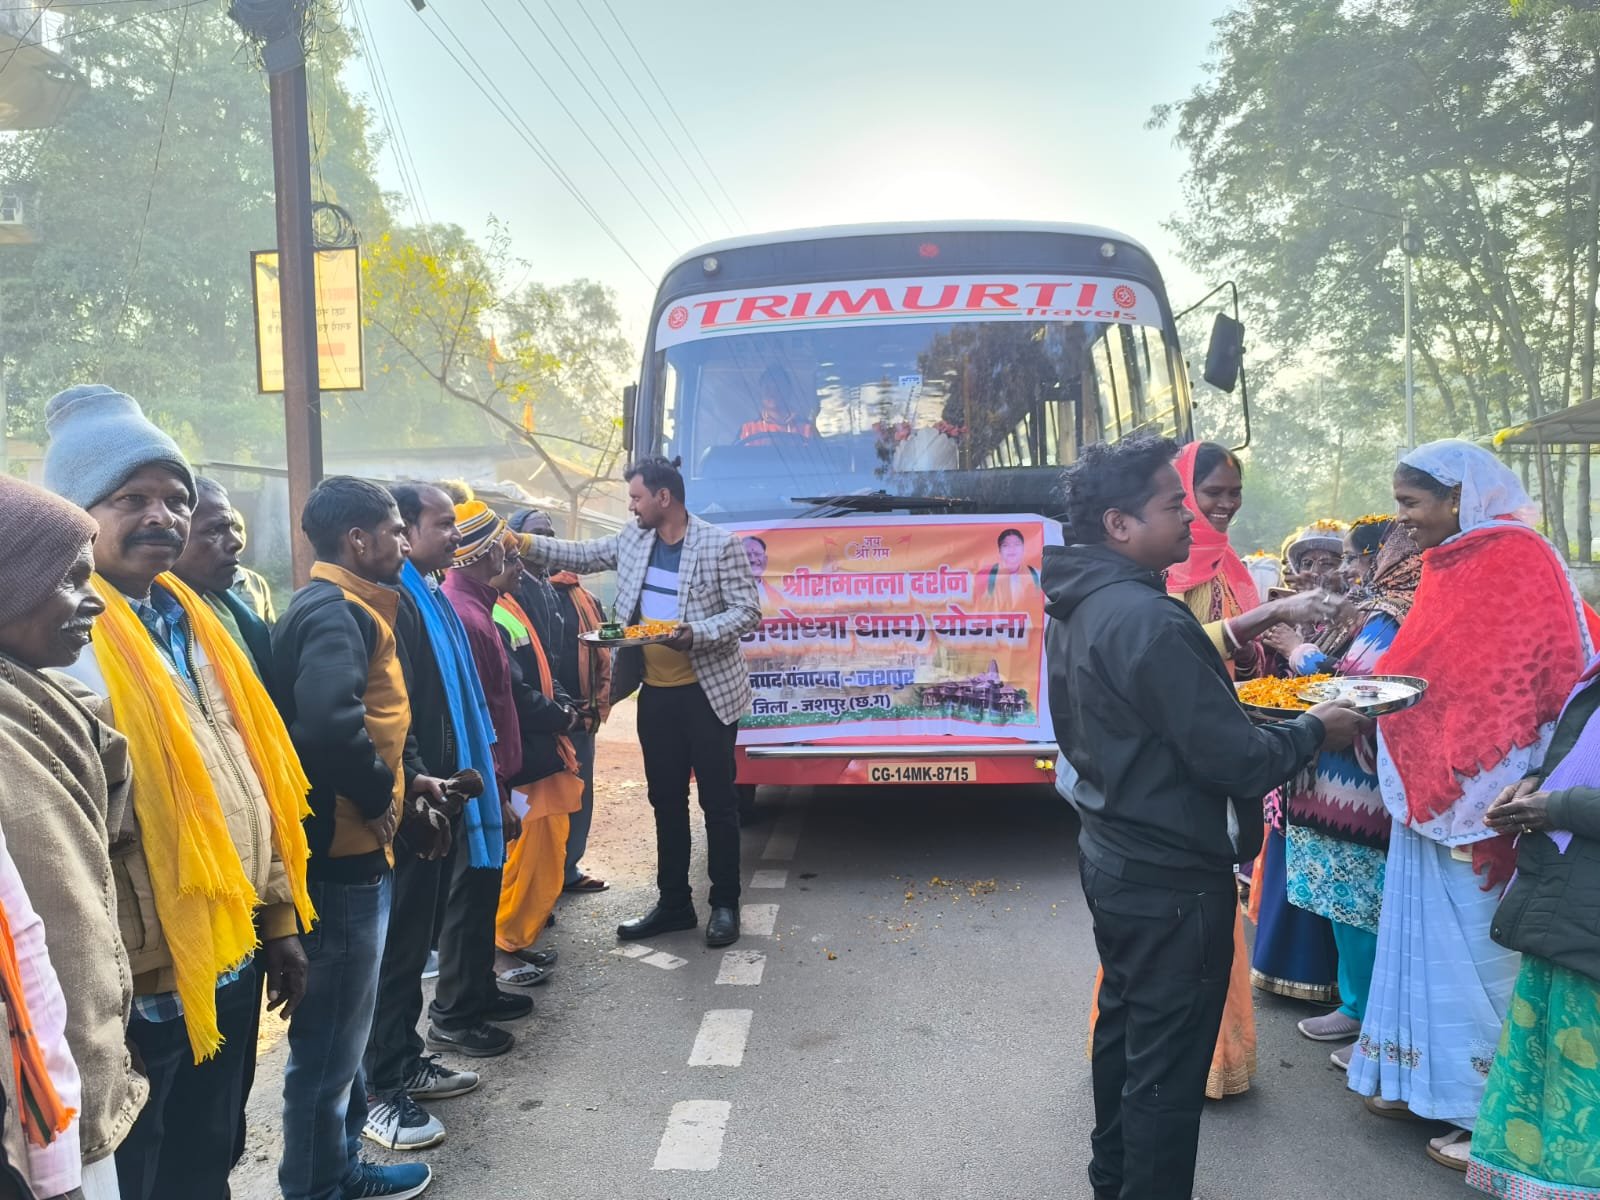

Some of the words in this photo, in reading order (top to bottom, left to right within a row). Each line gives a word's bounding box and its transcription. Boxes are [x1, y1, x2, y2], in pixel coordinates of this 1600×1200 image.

[693, 283, 1098, 326] TRIMURTI
[1024, 307, 1137, 321] Travels
[782, 567, 905, 597] श्रीरामलला
[909, 565, 970, 594] दर्शन
[855, 613, 926, 643] धाम)
[932, 606, 1028, 639] योजना
[784, 666, 840, 688] पंचायत
[854, 669, 915, 690] जशपुर
[751, 698, 788, 715] जिला
[800, 696, 847, 715] जशपुर
[849, 694, 892, 711] (छ.ग)
[871, 766, 969, 781] CG-14MK-8715
